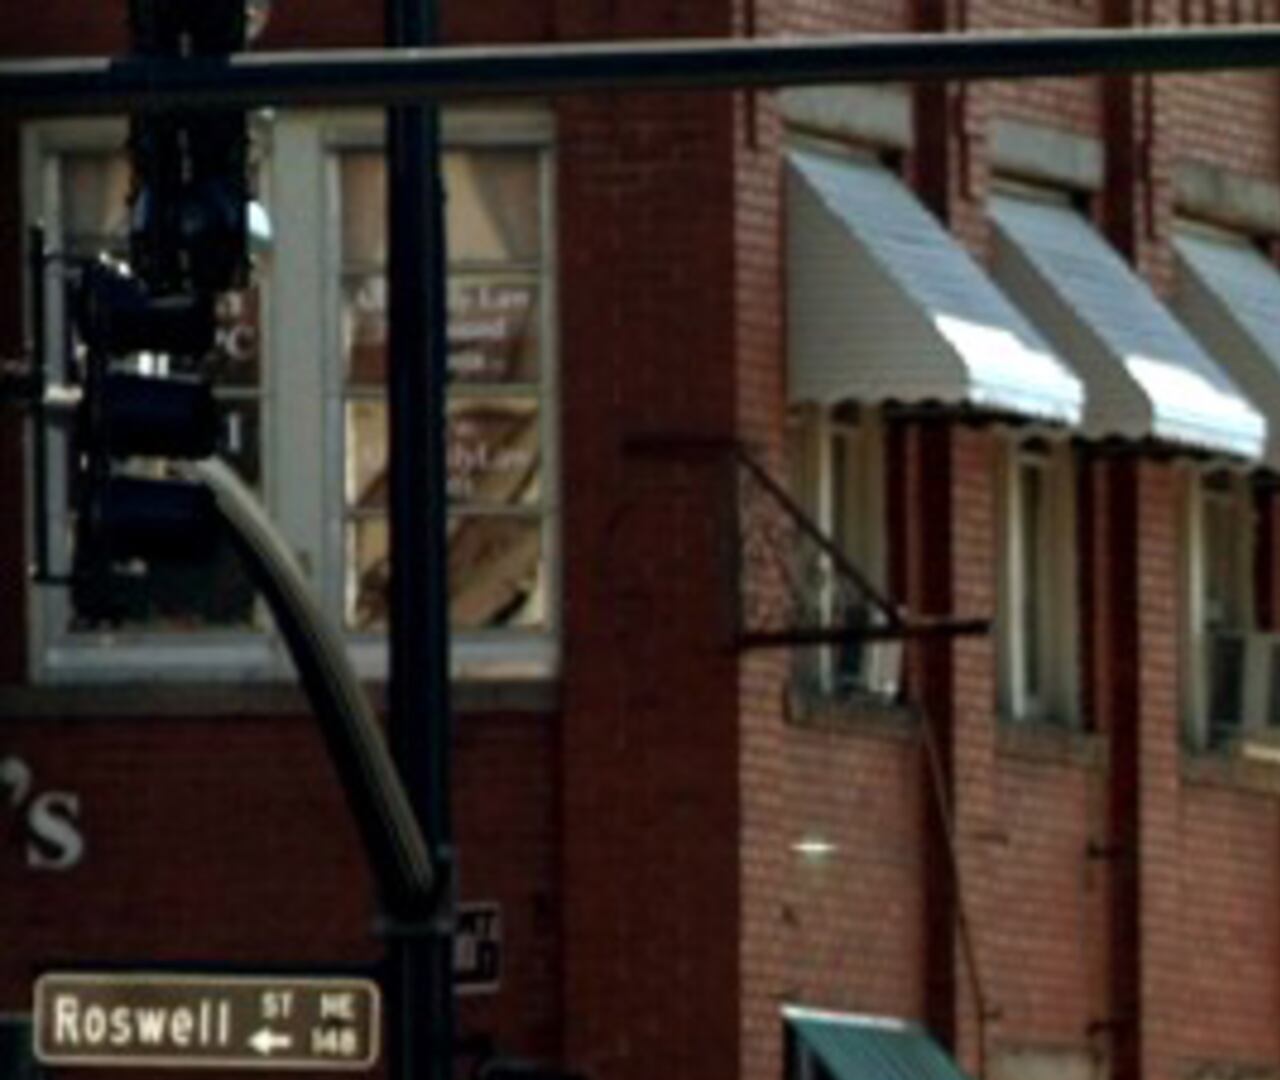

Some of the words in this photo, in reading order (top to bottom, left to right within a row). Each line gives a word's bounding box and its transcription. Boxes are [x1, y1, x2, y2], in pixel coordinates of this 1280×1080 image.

[54, 995, 230, 1046] Roswell
[260, 993, 292, 1018] ST
[319, 994, 355, 1019] NE
[311, 1026, 357, 1054] 148
